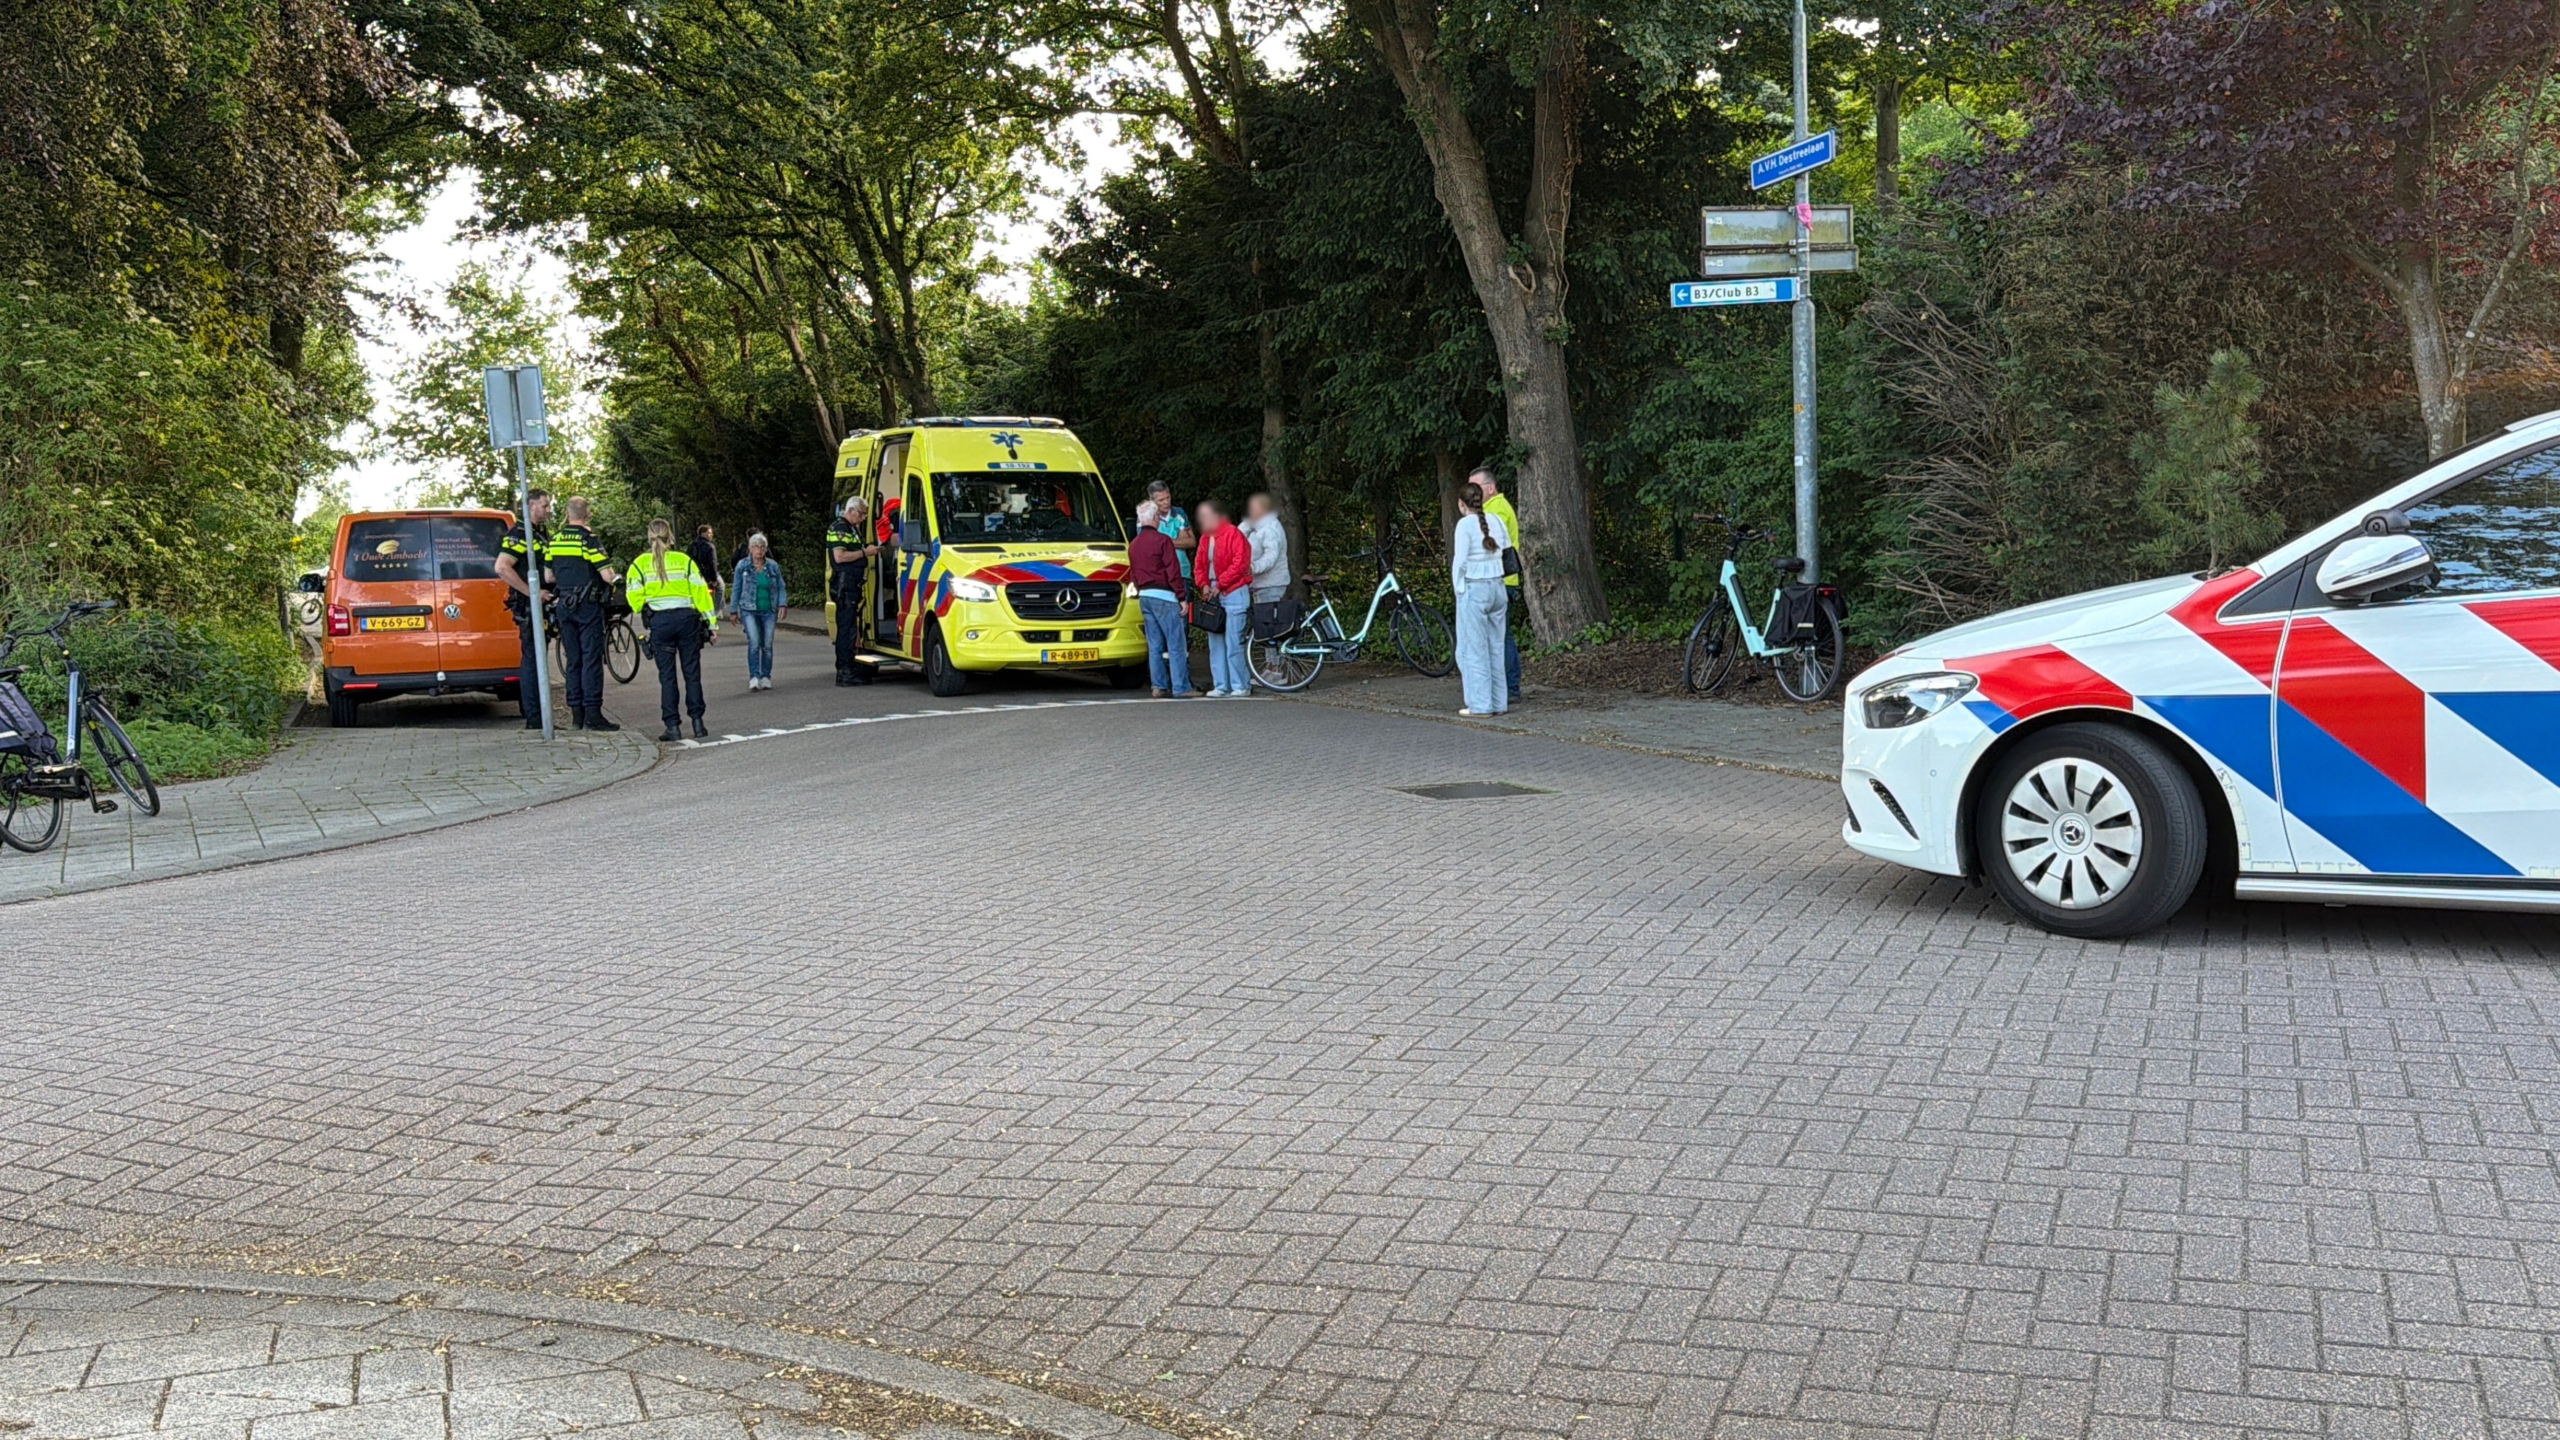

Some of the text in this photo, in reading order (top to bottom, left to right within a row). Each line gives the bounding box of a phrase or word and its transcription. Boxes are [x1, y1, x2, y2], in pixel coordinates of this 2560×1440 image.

[1779, 141, 1825, 166] Destreelaan
[1694, 286, 1759, 299] B3/Club B3
[386, 549, 427, 560] Ambacht
[369, 617, 421, 628] V-669-GZ
[1050, 650, 1096, 660] R-489-BV
